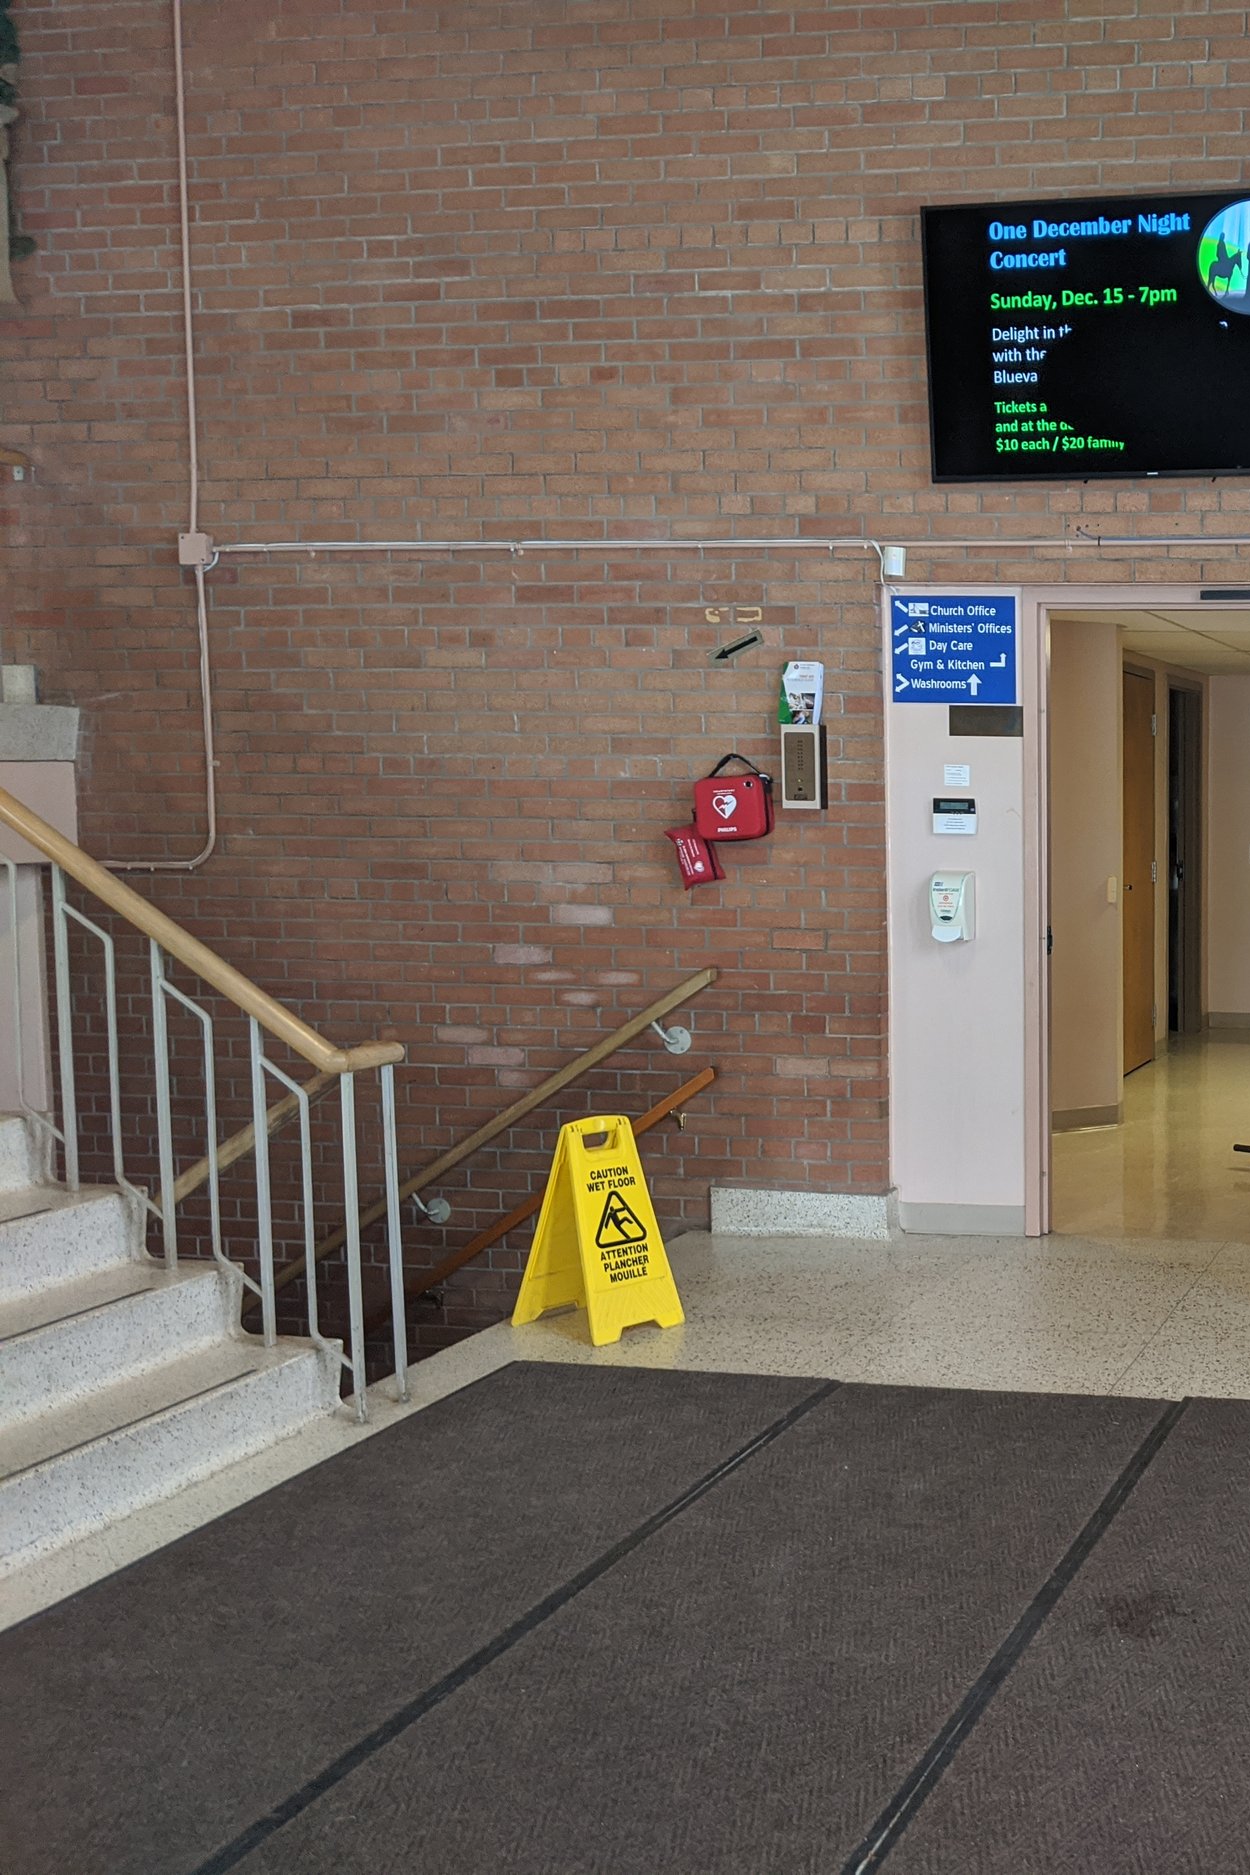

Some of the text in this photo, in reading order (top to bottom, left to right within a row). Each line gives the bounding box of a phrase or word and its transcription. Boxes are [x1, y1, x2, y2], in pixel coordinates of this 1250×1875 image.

[989, 213, 1190, 240] One December Night
[990, 249, 1066, 269] Concert
[991, 291, 1057, 311] Sunday,
[1062, 290, 1098, 306] Dec.
[1103, 288, 1123, 304] 15
[1139, 287, 1177, 305] 7pm
[992, 327, 1039, 343] Delight
[1043, 326, 1055, 339] in
[993, 348, 1021, 362] with
[994, 370, 1038, 383] Blueva
[994, 401, 1037, 413] Tickets
[996, 420, 1018, 432] and
[1021, 421, 1034, 431] at
[1036, 419, 1057, 431] the
[996, 438, 1018, 452] $10
[1021, 438, 1049, 450] each
[1053, 437, 1058, 451] /
[1062, 436, 1084, 450] $20
[930, 606, 996, 616] Church Office
[978, 623, 1012, 633] Offices
[930, 641, 973, 652] Day Care
[911, 660, 984, 671] Gym & Kitchen
[911, 679, 966, 688] Washrooms
[590, 1166, 628, 1180] CAUTION
[587, 1176, 635, 1192] WET FLOOR
[601, 1243, 648, 1260] ATTENTION
[604, 1256, 649, 1272] PLANCHER
[610, 1264, 647, 1283] MOUILLÉ
